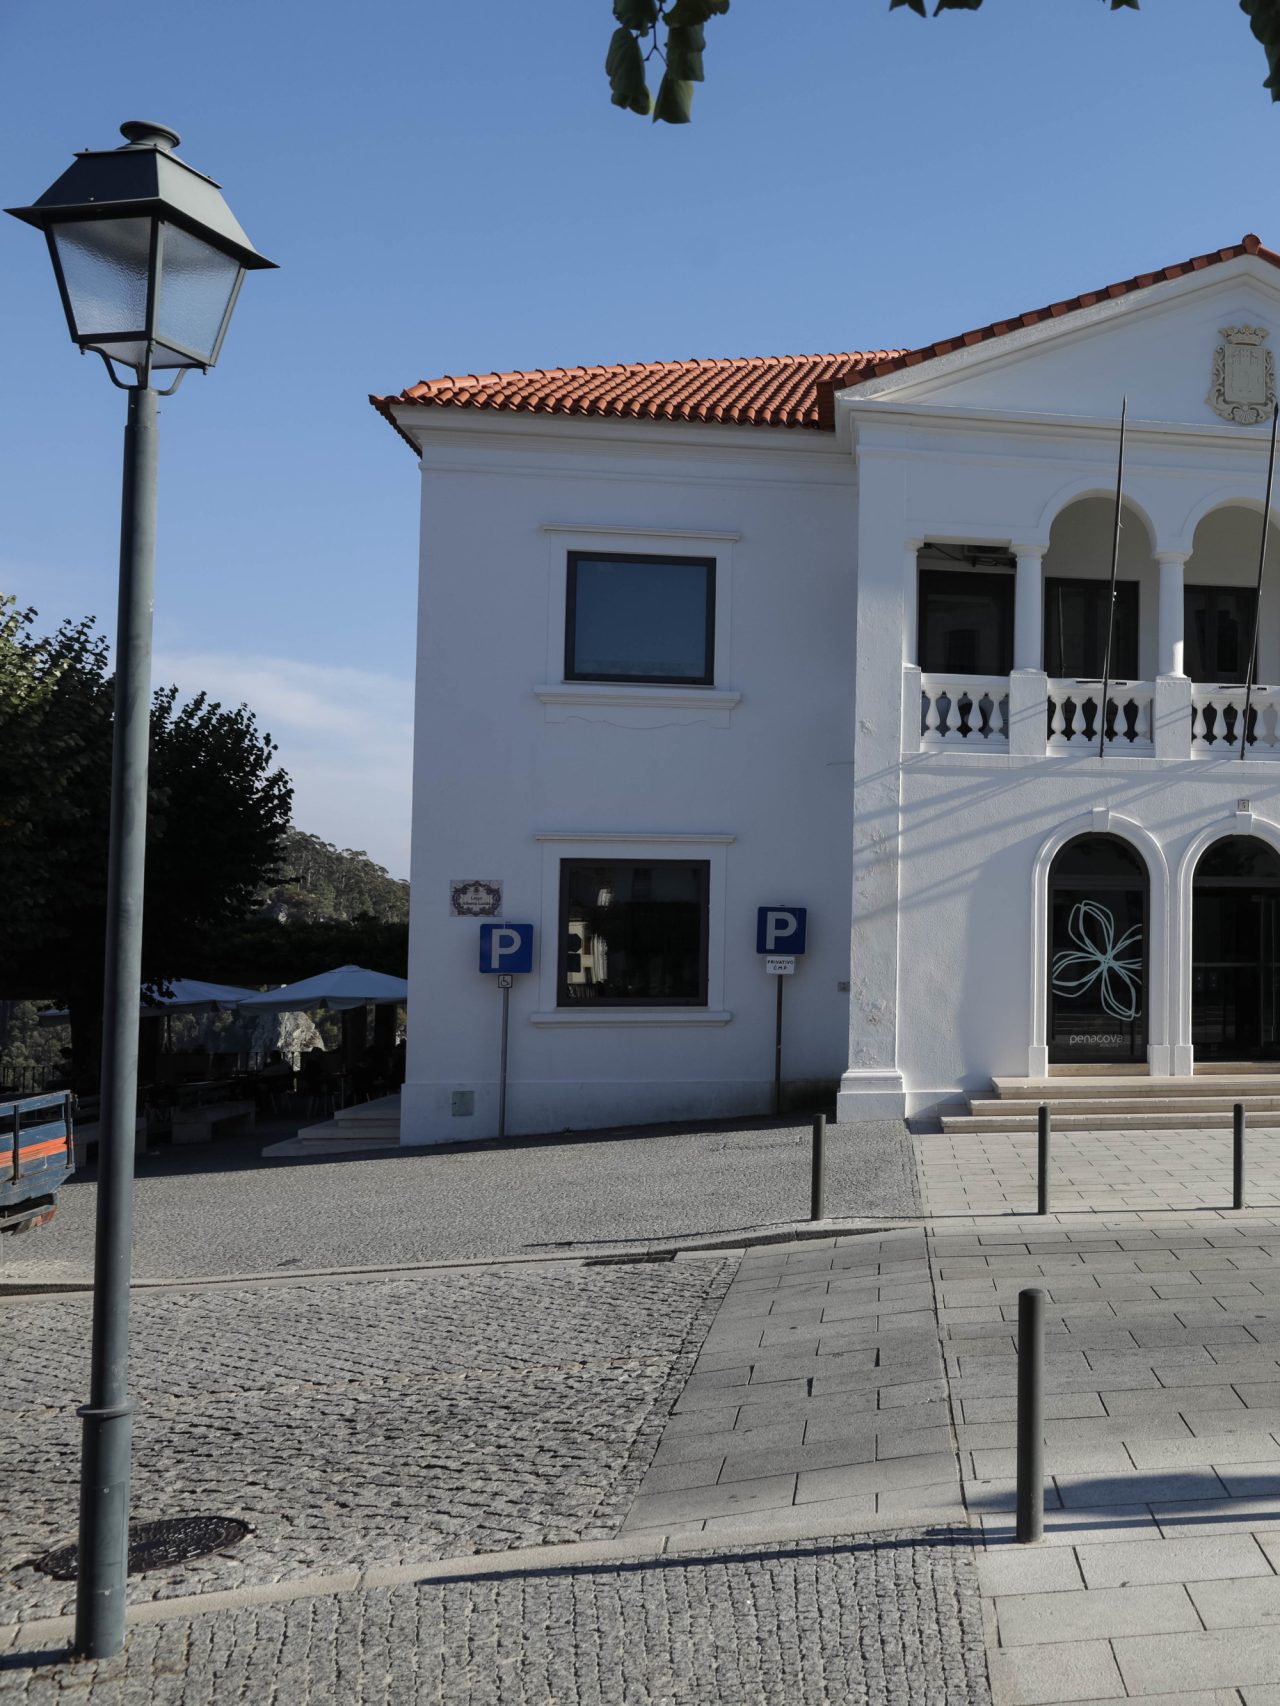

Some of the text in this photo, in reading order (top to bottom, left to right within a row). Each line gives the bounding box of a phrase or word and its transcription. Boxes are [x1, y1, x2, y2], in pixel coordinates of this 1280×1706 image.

[491, 928, 522, 969] P
[765, 911, 797, 950] P
[1069, 1034, 1124, 1046] penacova
